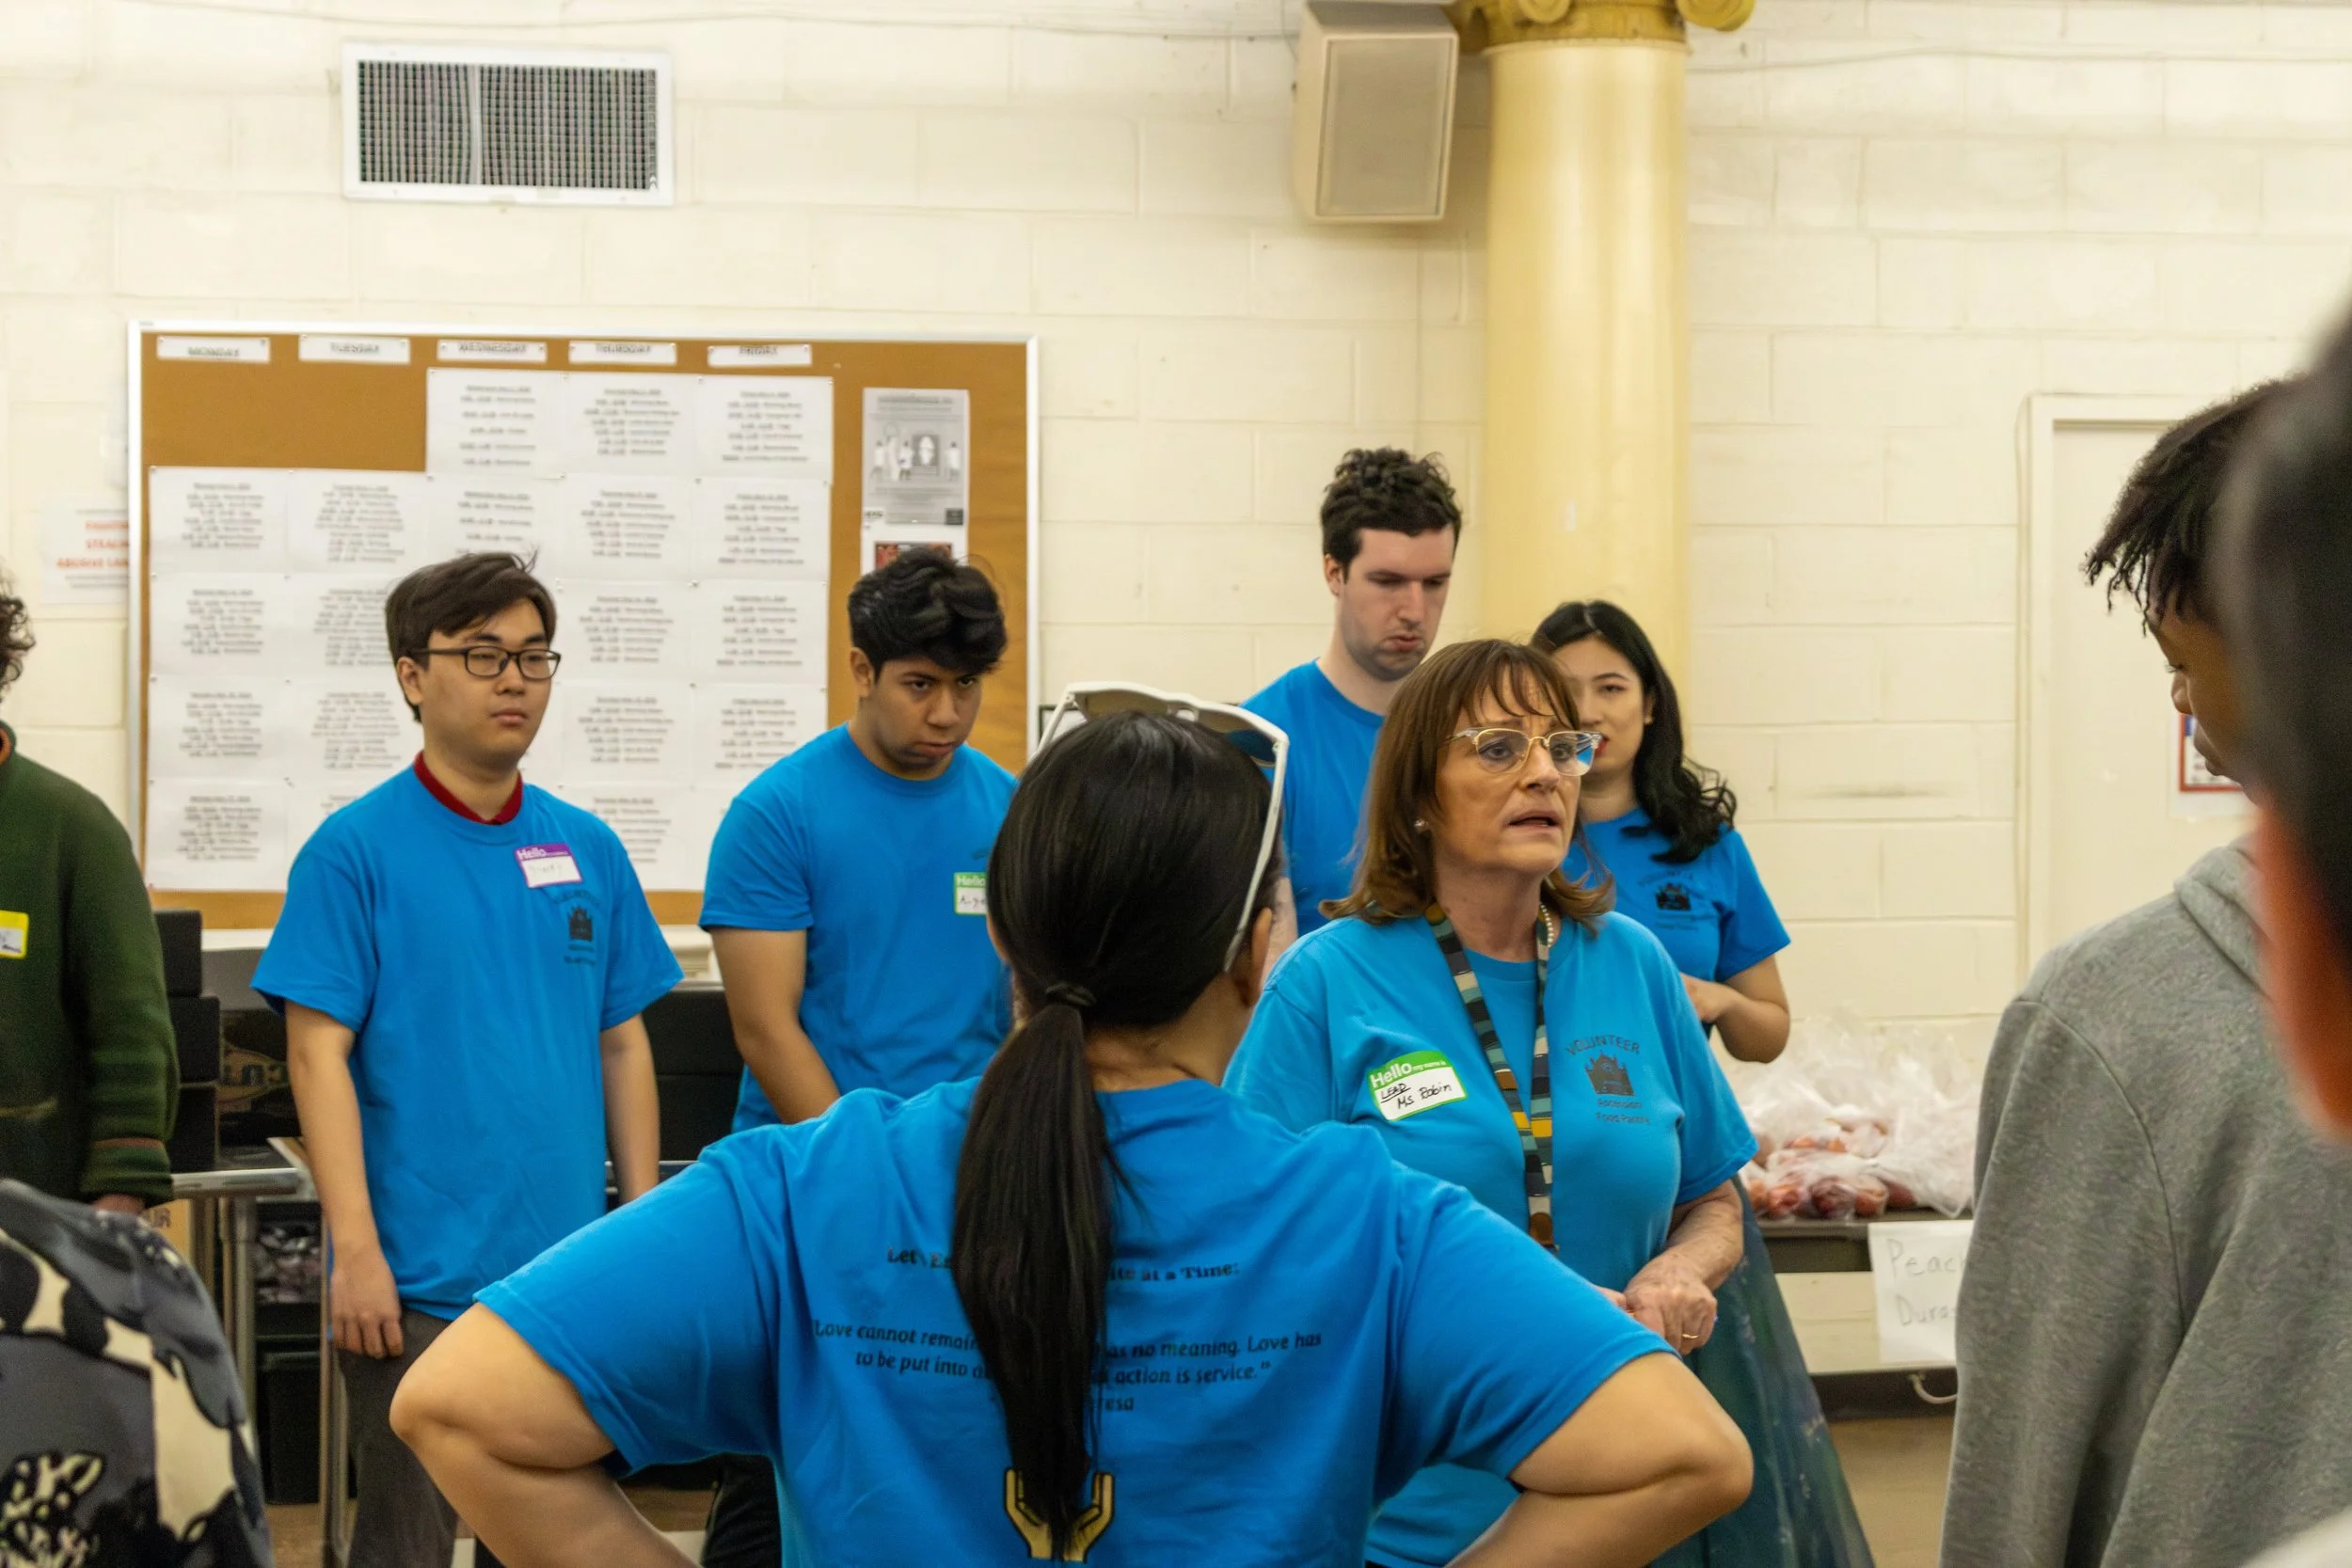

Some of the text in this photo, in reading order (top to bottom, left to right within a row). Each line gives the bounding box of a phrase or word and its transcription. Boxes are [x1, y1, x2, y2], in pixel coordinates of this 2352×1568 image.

[516, 847, 547, 861] Hello
[1565, 1034, 1641, 1055] VOLUNTEER
[1369, 1062, 1412, 1088] Hello
[1380, 1083, 1407, 1100] LEAD
[1109, 1266, 1136, 1281] ite
[1181, 1262, 1240, 1280] Time:
[1894, 1293, 1956, 1327] Dura
[857, 1324, 916, 1345] cannot
[1105, 1331, 1322, 1358] as no meaning. Love has
[855, 1351, 873, 1366] to
[877, 1350, 896, 1369] be
[898, 1355, 930, 1375] put
[934, 1356, 968, 1377] into
[1115, 1367, 1170, 1385] action
[1176, 1369, 1190, 1385] is
